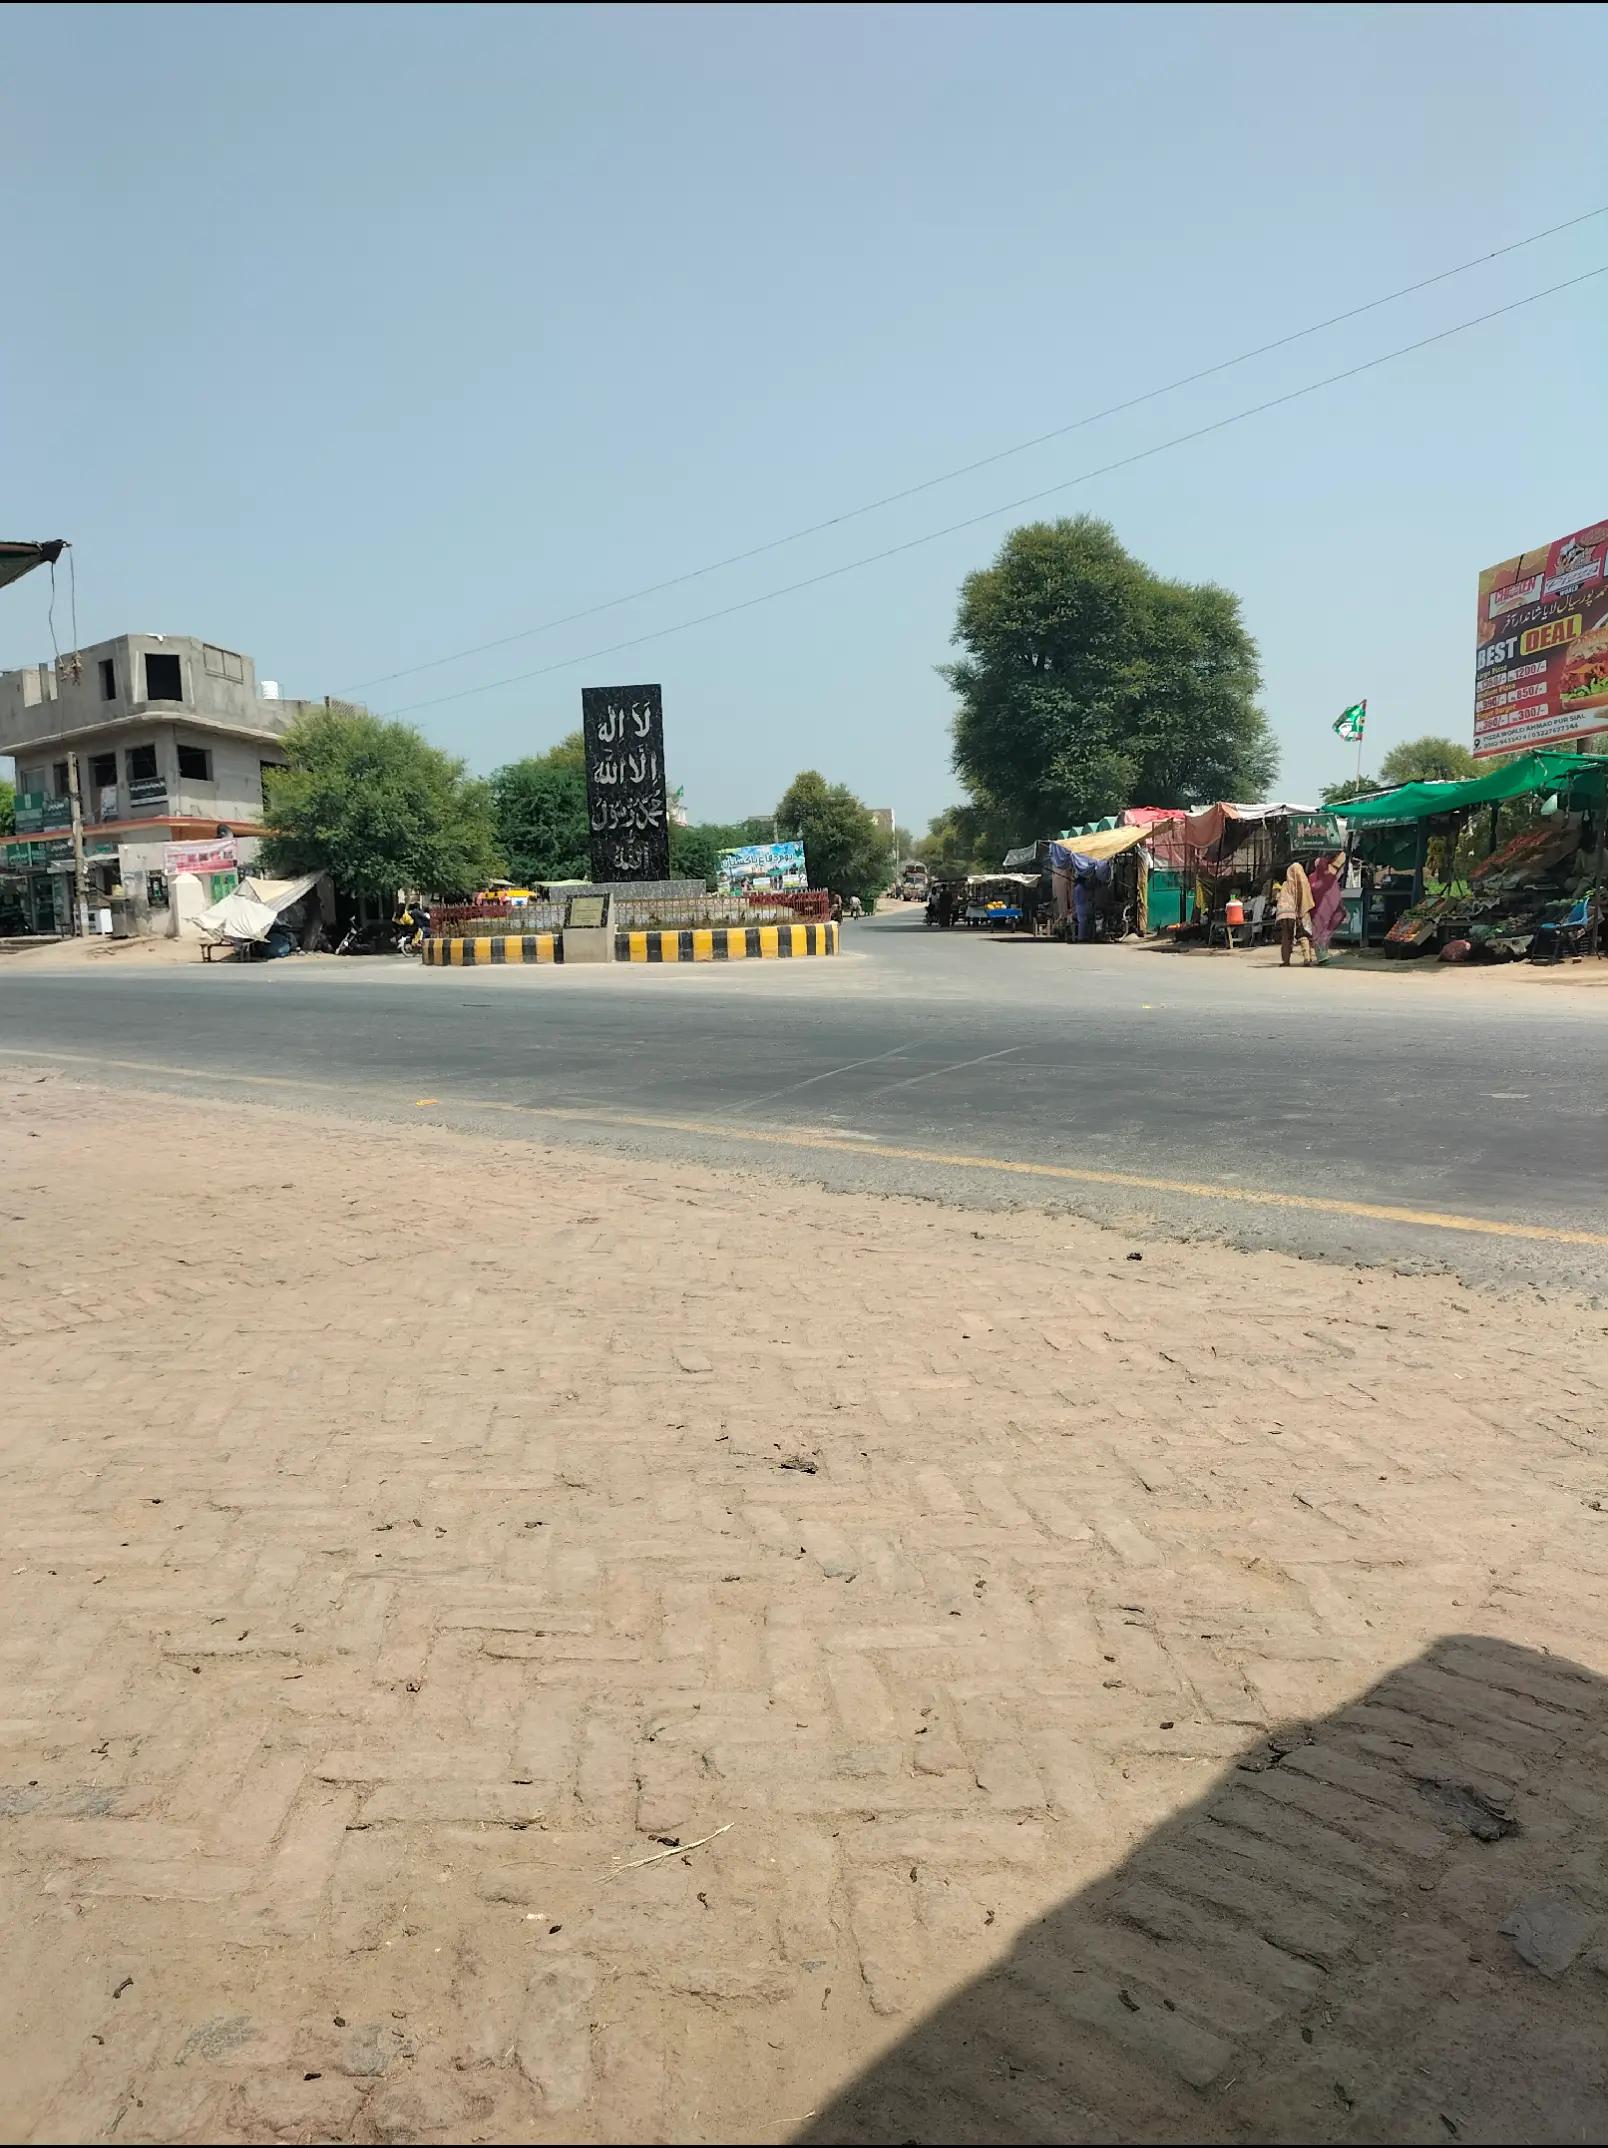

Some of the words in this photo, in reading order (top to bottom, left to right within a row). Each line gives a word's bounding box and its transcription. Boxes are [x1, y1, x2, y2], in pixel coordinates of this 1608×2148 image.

[1477, 636, 1518, 671] BEST
[1525, 617, 1577, 653] DEAL
[1525, 720, 1553, 732] AHMAD
[1553, 716, 1570, 726] PUR
[1569, 713, 1586, 722] SIAL
